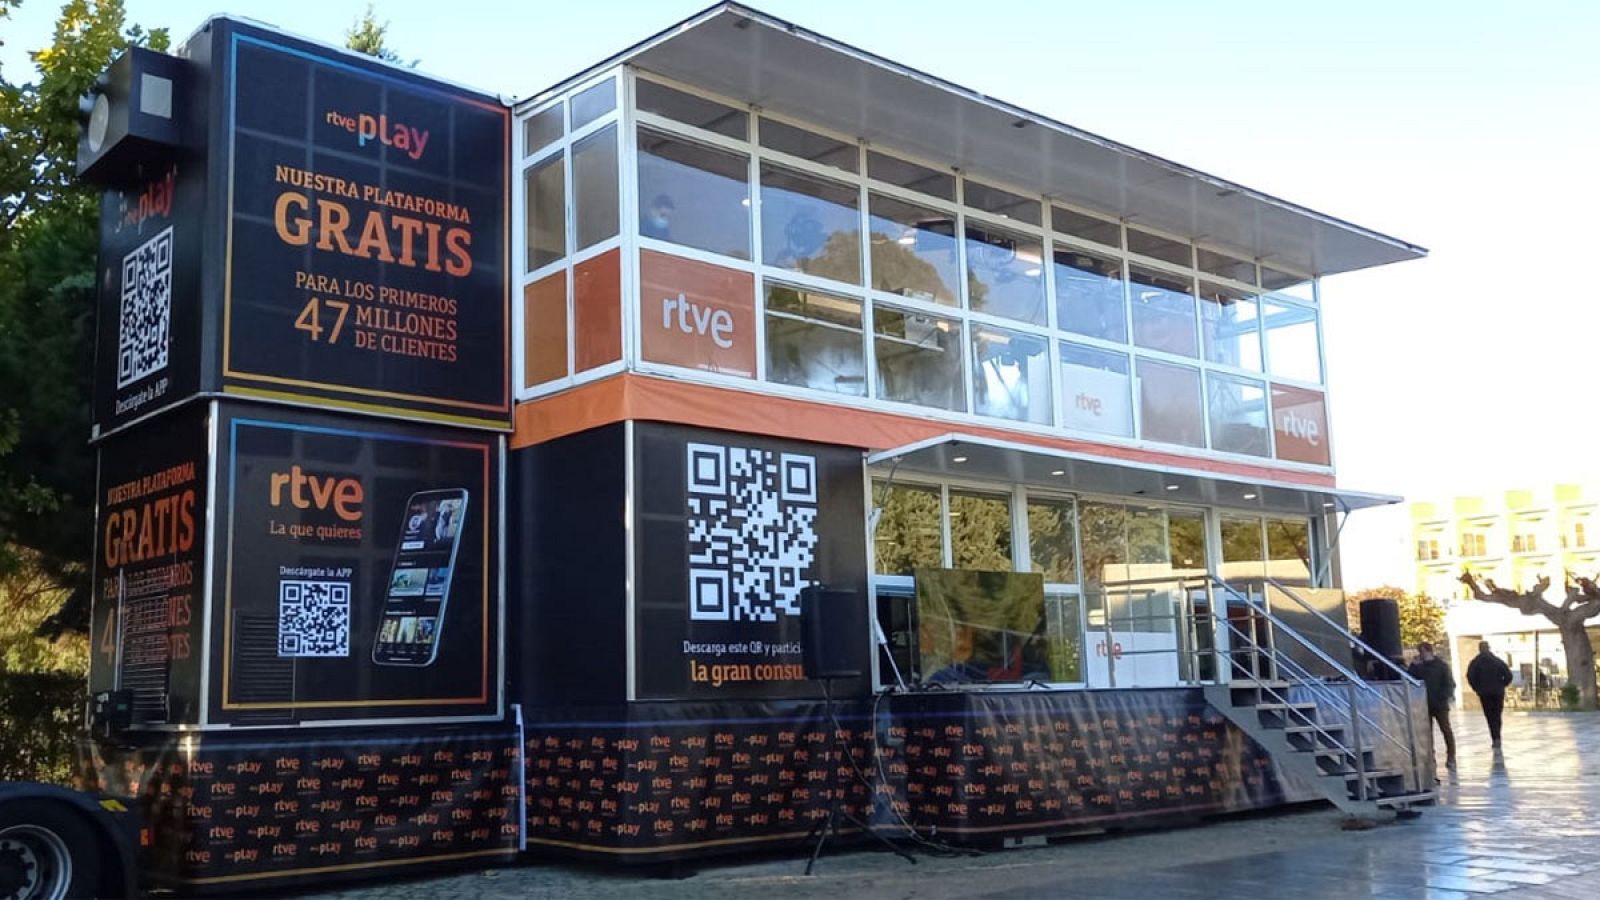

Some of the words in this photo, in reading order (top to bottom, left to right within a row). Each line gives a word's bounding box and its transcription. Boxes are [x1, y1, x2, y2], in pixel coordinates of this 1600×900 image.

[326, 111, 358, 132] rtve
[358, 113, 429, 160] play
[275, 165, 359, 199] NUESTRA
[363, 185, 470, 224] PLATAFORMA
[274, 191, 473, 278] GRATIS
[296, 271, 340, 295] PARA
[345, 280, 374, 301] LOS
[379, 288, 457, 316] PRIMEROS
[294, 297, 350, 345] 47
[355, 305, 457, 341] MILLONES
[663, 293, 733, 348] rtve
[355, 331, 377, 350] DE
[380, 335, 457, 362] CLIENTES
[1075, 392, 1102, 416] rtve
[1283, 413, 1320, 446] rtve
[143, 461, 195, 494] PLATAFORMA
[270, 465, 364, 521] rtve
[105, 489, 195, 569] GRATIS
[270, 521, 286, 535] La
[289, 526, 314, 540] que
[316, 526, 363, 541] quieres
[326, 568, 335, 577] la
[336, 568, 353, 578] APP
[683, 640, 727, 656] Descarga
[728, 642, 748, 653] este
[764, 643, 770, 656] y
[772, 641, 801, 656] partici
[1096, 640, 1122, 660] rte
[690, 660, 708, 681] la
[711, 664, 751, 687] gran
[754, 664, 806, 681] consu
[188, 761, 214, 773] rtve
[238, 761, 262, 775] play
[276, 757, 300, 771] rtve
[321, 758, 344, 770] play
[211, 781, 236, 794] rtve
[259, 782, 283, 794] play
[297, 777, 321, 789] rtve
[341, 777, 364, 790] play
[187, 805, 212, 818] rtve
[236, 805, 260, 818] play
[275, 800, 298, 812] rtve
[321, 800, 341, 812] play
[210, 826, 234, 838] rtve
[258, 826, 281, 839] play
[296, 819, 320, 832] rtve
[340, 819, 363, 833] play
[186, 851, 210, 863] rtve
[234, 849, 258, 863] play
[273, 843, 296, 855] rtve
[320, 842, 341, 855] play
